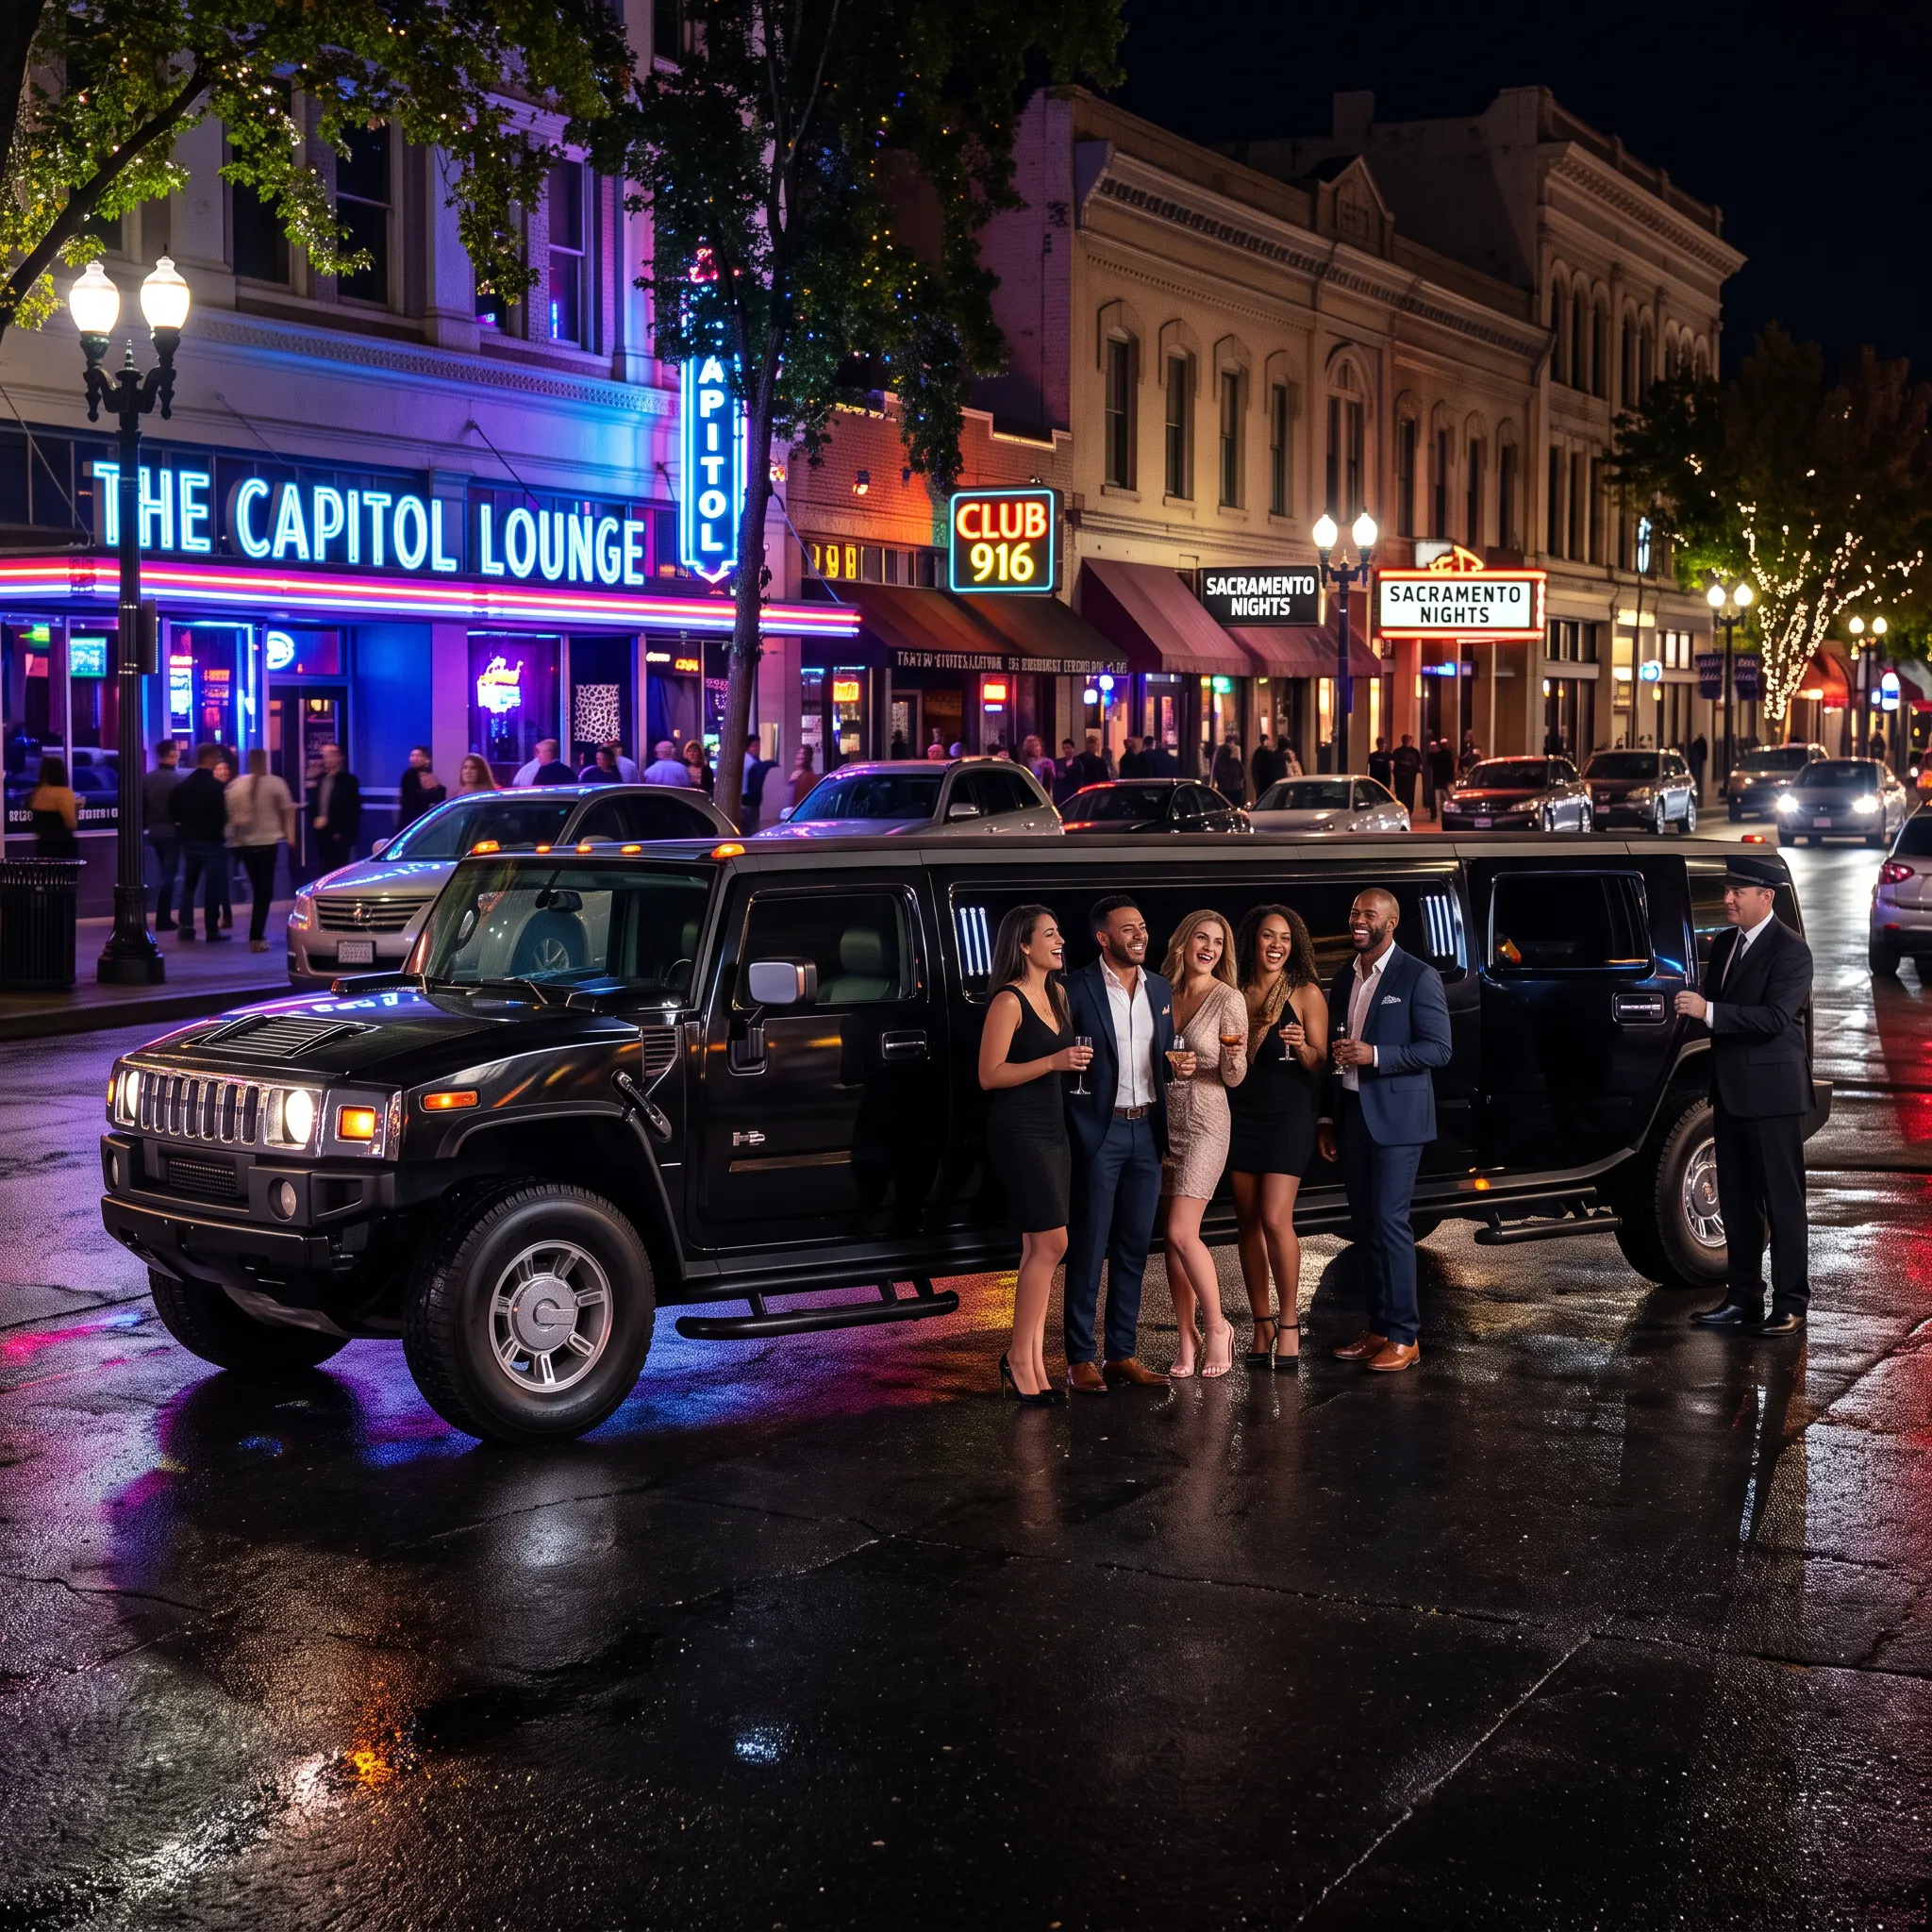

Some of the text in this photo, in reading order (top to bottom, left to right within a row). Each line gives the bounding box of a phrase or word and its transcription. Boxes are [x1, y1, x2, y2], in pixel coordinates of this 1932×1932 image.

[698, 355, 727, 552] APITOL
[93, 460, 644, 586] THE CAPITOL LOUNGE
[956, 502, 1047, 540] CLUB
[970, 541, 1035, 582] 916
[1206, 575, 1315, 595] SACRAMENTO
[1390, 585, 1522, 603] SACRAMENTO
[1231, 597, 1291, 616] NIGHTS
[1420, 607, 1490, 624] NIGHTS
